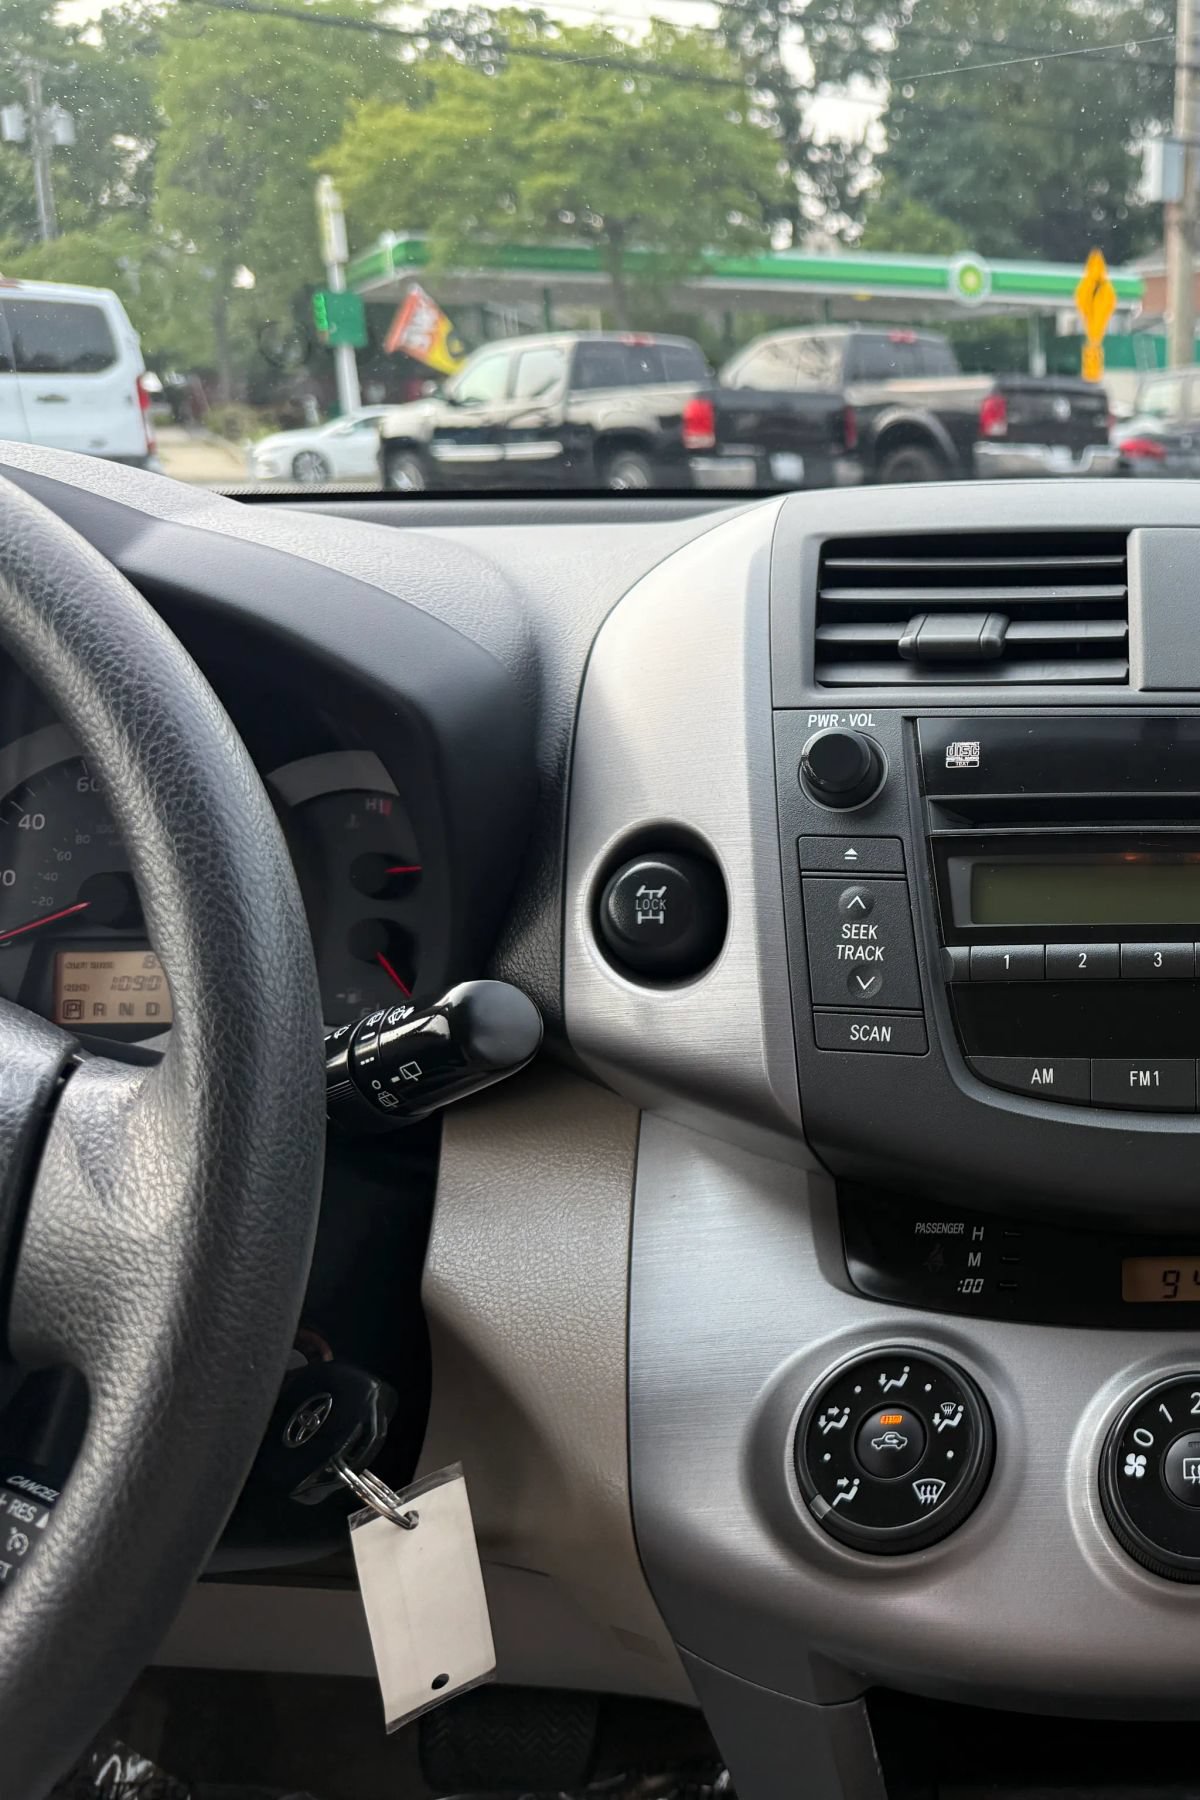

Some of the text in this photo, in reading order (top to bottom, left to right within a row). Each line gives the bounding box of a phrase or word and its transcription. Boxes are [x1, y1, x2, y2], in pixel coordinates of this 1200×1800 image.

[18, 814, 45, 830] 40
[56, 851, 72, 861] 60
[635, 899, 667, 910] LOCK
[842, 924, 878, 940] SEEK
[837, 945, 884, 961] TRACK
[1078, 953, 1087, 968] 2
[1153, 953, 1162, 968] 3
[1003, 954, 1010, 970] 1
[119, 1003, 135, 1016] N
[146, 1002, 160, 1016] D
[850, 1025, 891, 1042] SCAN
[1031, 1069, 1054, 1085] AM
[915, 1222, 964, 1235] PASSENGER
[972, 1226, 984, 1241] H
[968, 1252, 981, 1267] M
[957, 1279, 984, 1294] :00
[1159, 1404, 1173, 1423] 1
[1133, 1428, 1154, 1447] 0
[6, 1475, 60, 1502] CANCEL
[7, 1499, 37, 1522] RES
